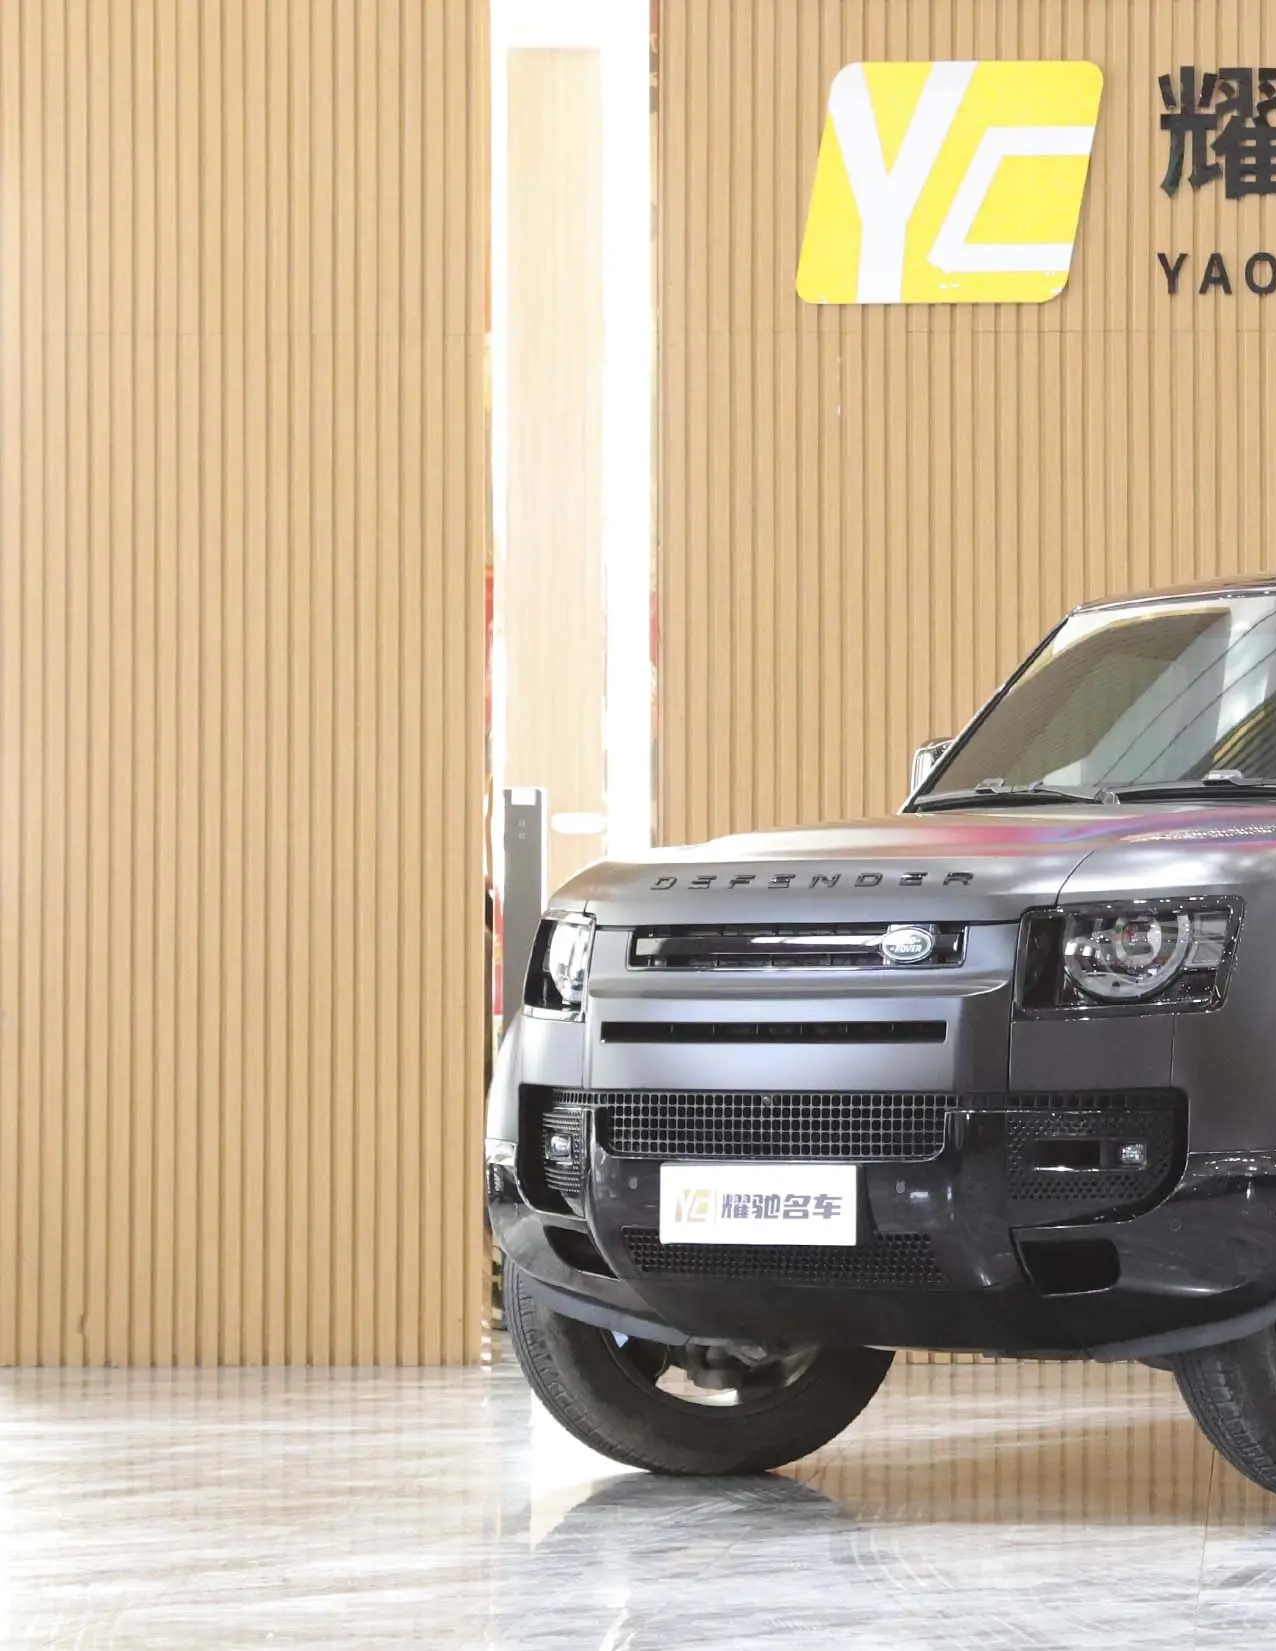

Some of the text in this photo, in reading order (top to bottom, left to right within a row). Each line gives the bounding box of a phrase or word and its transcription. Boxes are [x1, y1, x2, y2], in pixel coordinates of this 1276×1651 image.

[650, 871, 974, 891] DEFENDER
[721, 1193, 843, 1219] 耀驰名车
